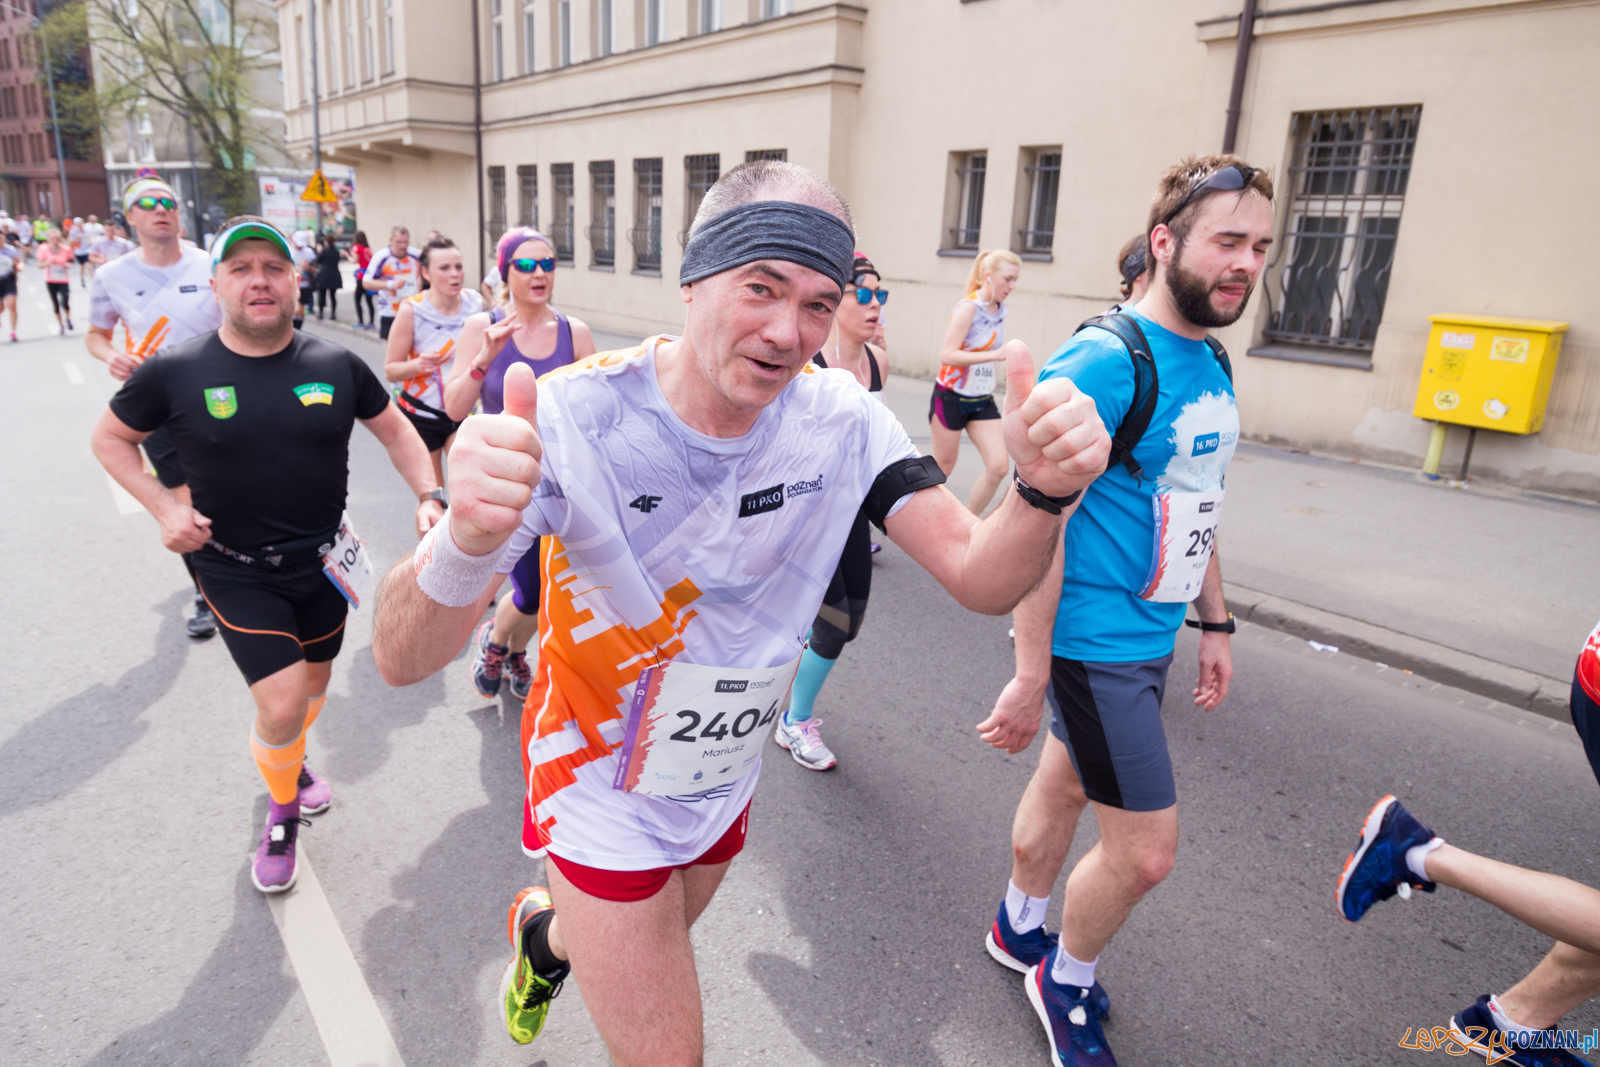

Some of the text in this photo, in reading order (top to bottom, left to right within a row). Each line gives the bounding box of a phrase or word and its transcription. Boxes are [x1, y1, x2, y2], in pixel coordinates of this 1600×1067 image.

[629, 494, 663, 513] 4F
[759, 491, 781, 507] PKO
[669, 698, 779, 743] 2404
[701, 744, 745, 759] Mariusz
